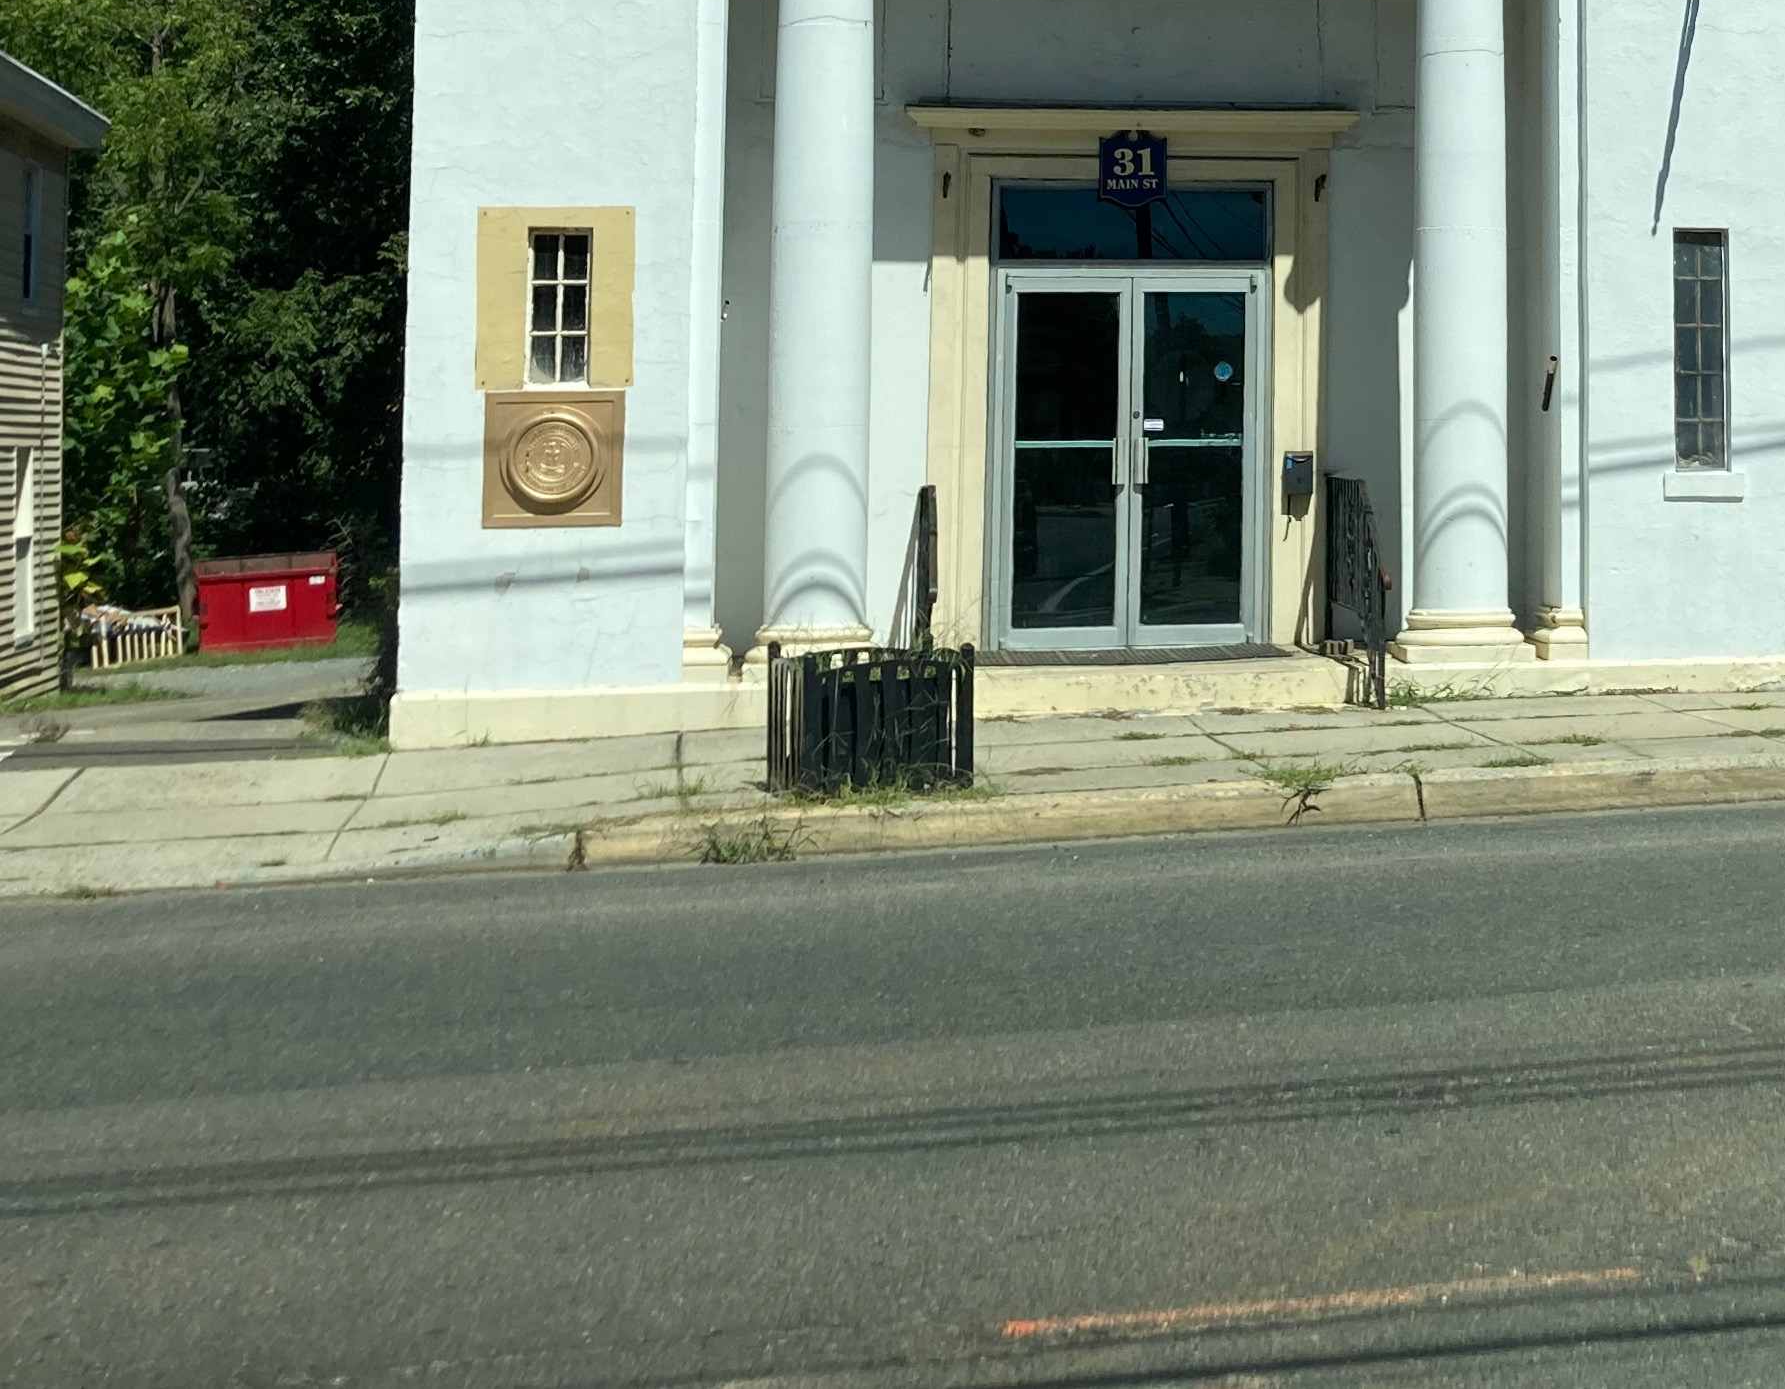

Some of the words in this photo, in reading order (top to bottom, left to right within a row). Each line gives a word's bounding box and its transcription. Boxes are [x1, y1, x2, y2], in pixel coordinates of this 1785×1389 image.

[1113, 147, 1155, 176] 31
[1107, 179, 1139, 190] MAIN
[1142, 178, 1158, 189] ST
